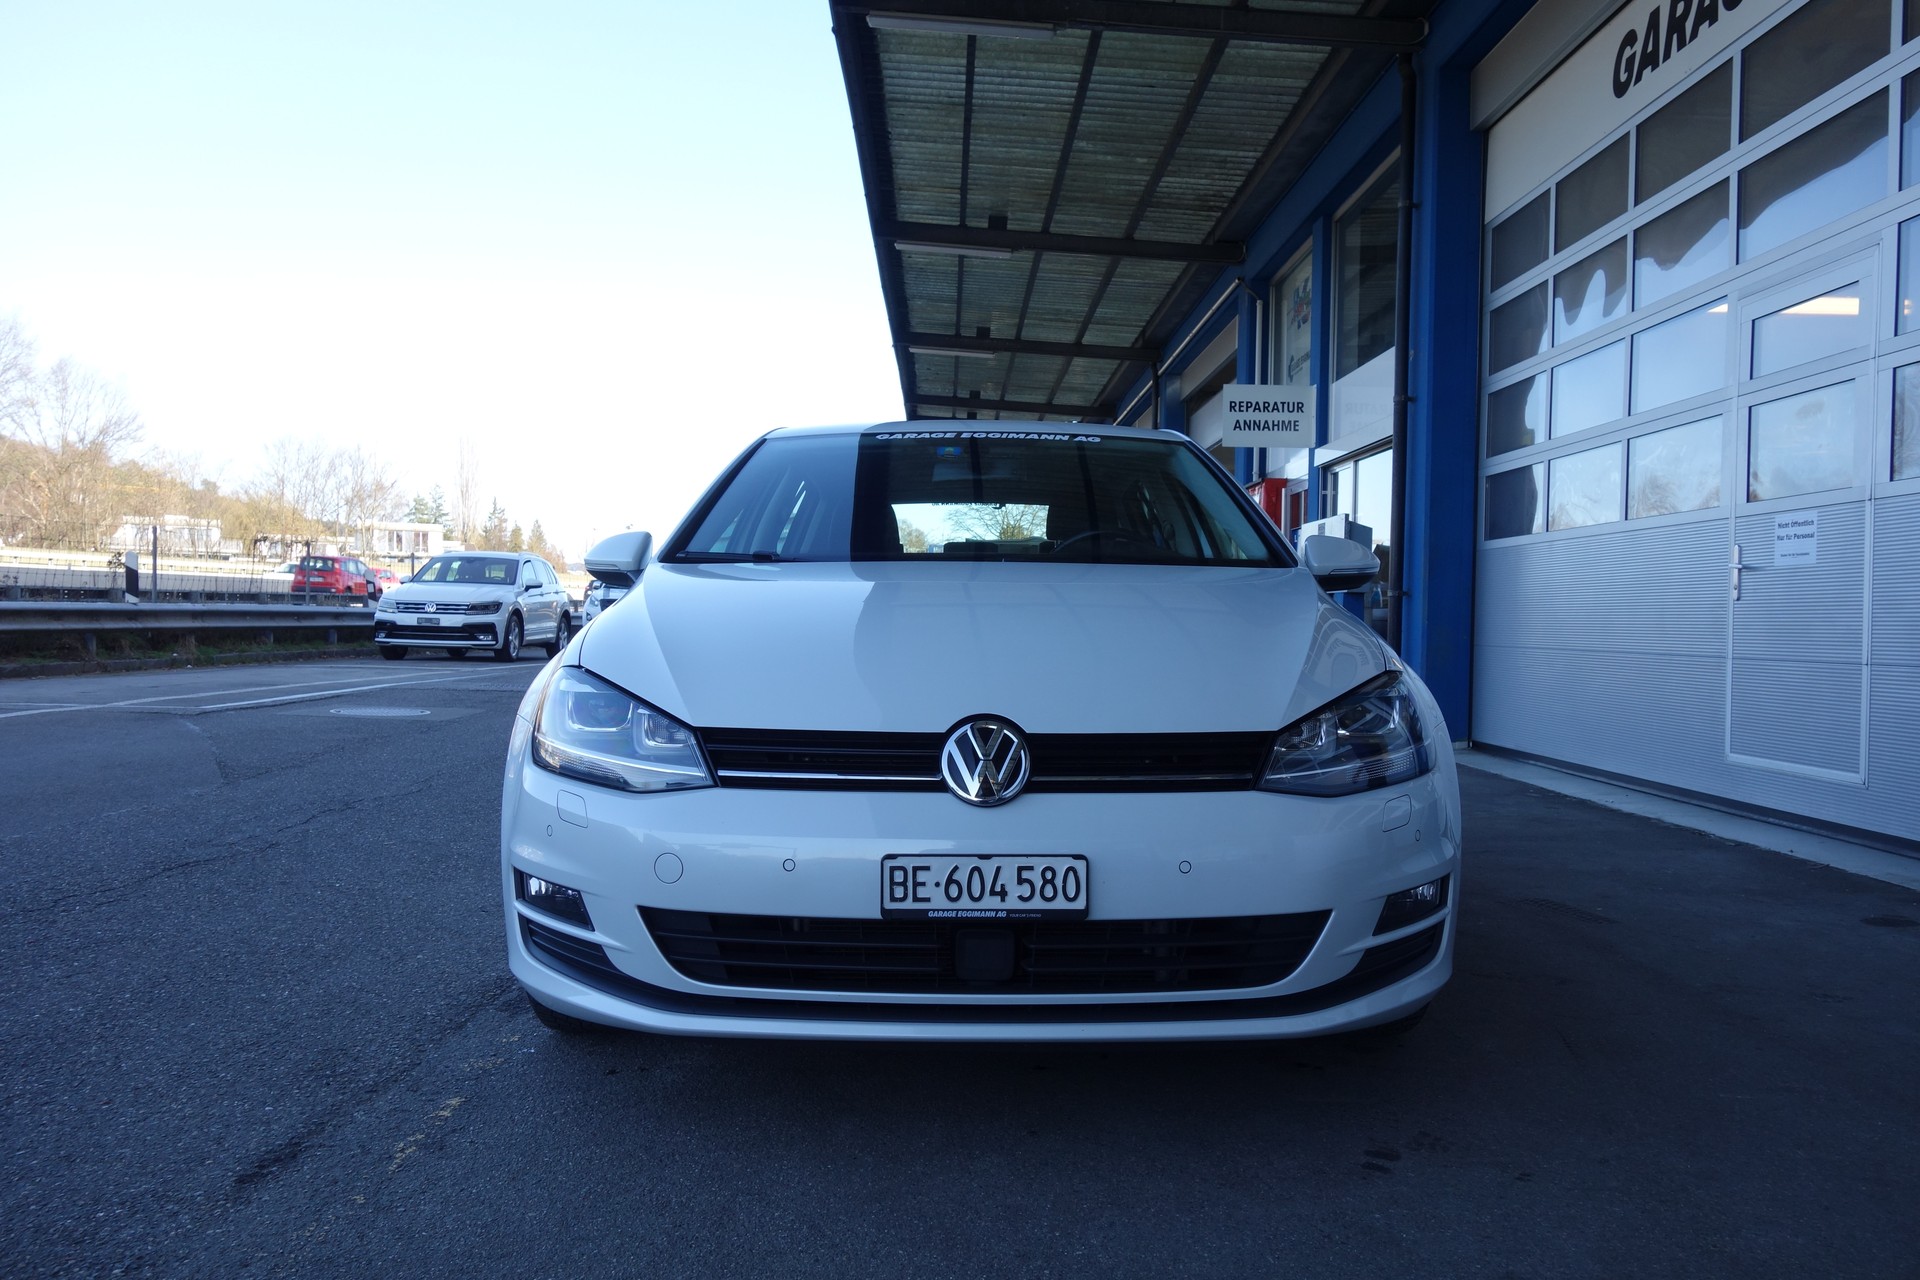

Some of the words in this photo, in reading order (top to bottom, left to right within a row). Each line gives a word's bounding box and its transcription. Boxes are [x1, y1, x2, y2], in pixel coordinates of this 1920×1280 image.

[1613, 0, 1744, 98] GARA
[1229, 401, 1304, 413] REPARATUR
[1233, 419, 1299, 432] ANNAHME
[875, 432, 957, 440] GARAGE
[960, 432, 1069, 441] EGGIMANN
[1073, 435, 1102, 443] AG
[928, 910, 957, 918] GARAGE
[957, 910, 996, 918] EGGIMANN
[997, 910, 1007, 918] AG
